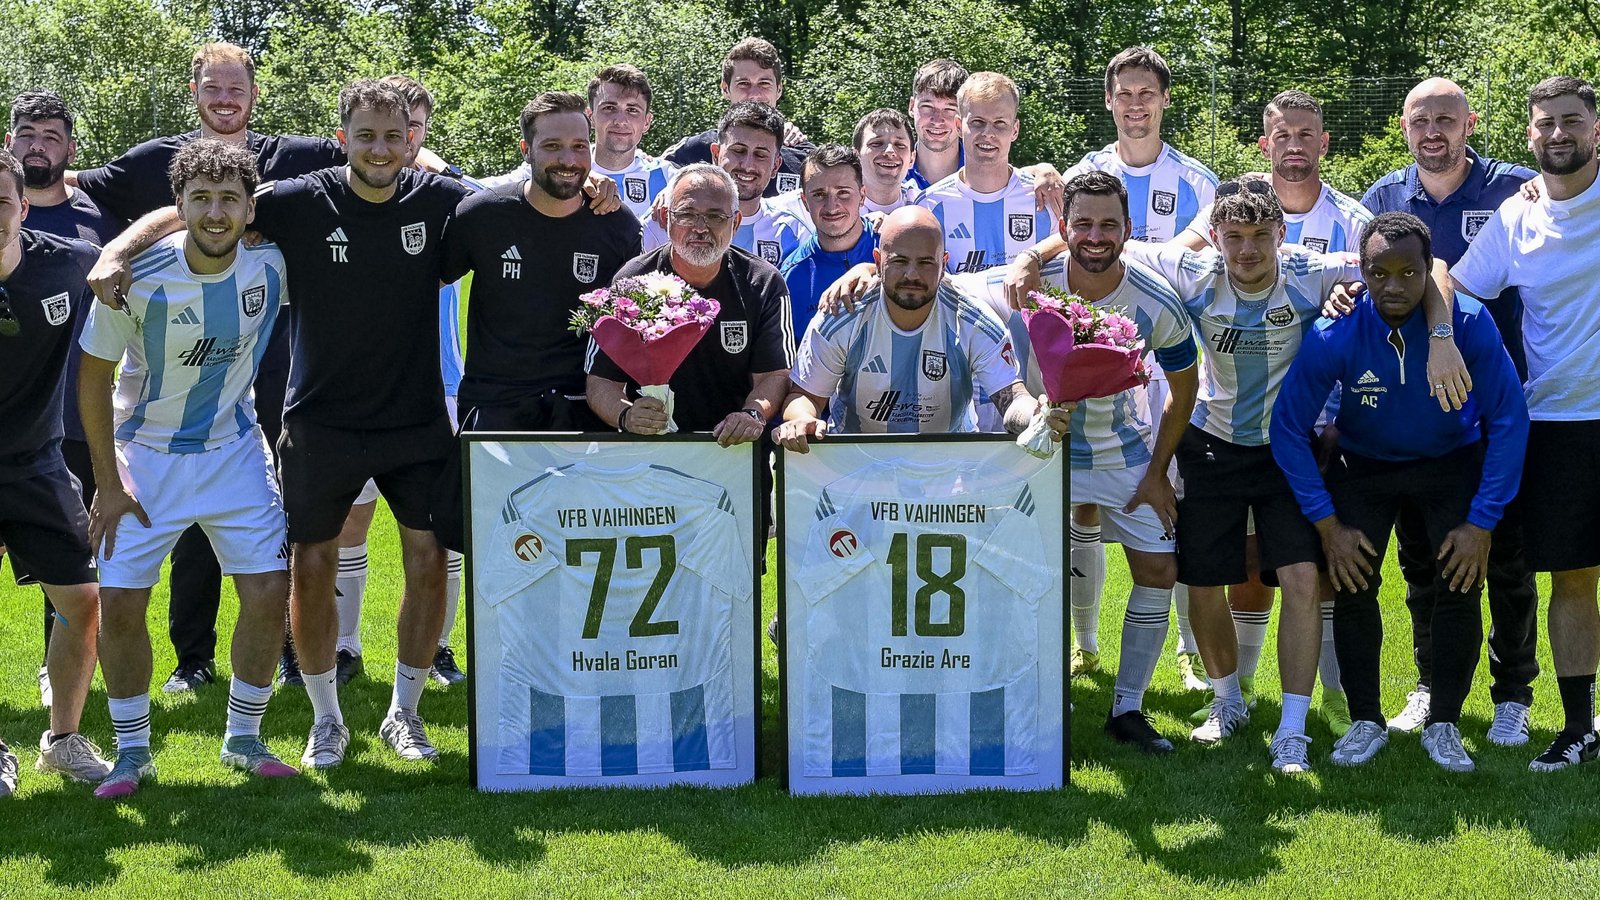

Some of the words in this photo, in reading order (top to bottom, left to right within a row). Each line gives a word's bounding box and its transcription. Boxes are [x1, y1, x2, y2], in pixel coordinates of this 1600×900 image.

[330, 245, 348, 262] TK
[503, 262, 521, 279] PH
[1361, 395, 1378, 408] AC
[557, 508, 588, 529] VFB
[591, 505, 677, 528] VAIHINGEN
[870, 501, 900, 521] VFB
[904, 503, 986, 523] VAIHINGEN
[565, 534, 679, 639] 72
[886, 532, 967, 637] 18
[572, 650, 620, 672] Hvala
[625, 649, 678, 671] Goran
[881, 647, 935, 669] Grazie
[940, 648, 971, 669] Are
